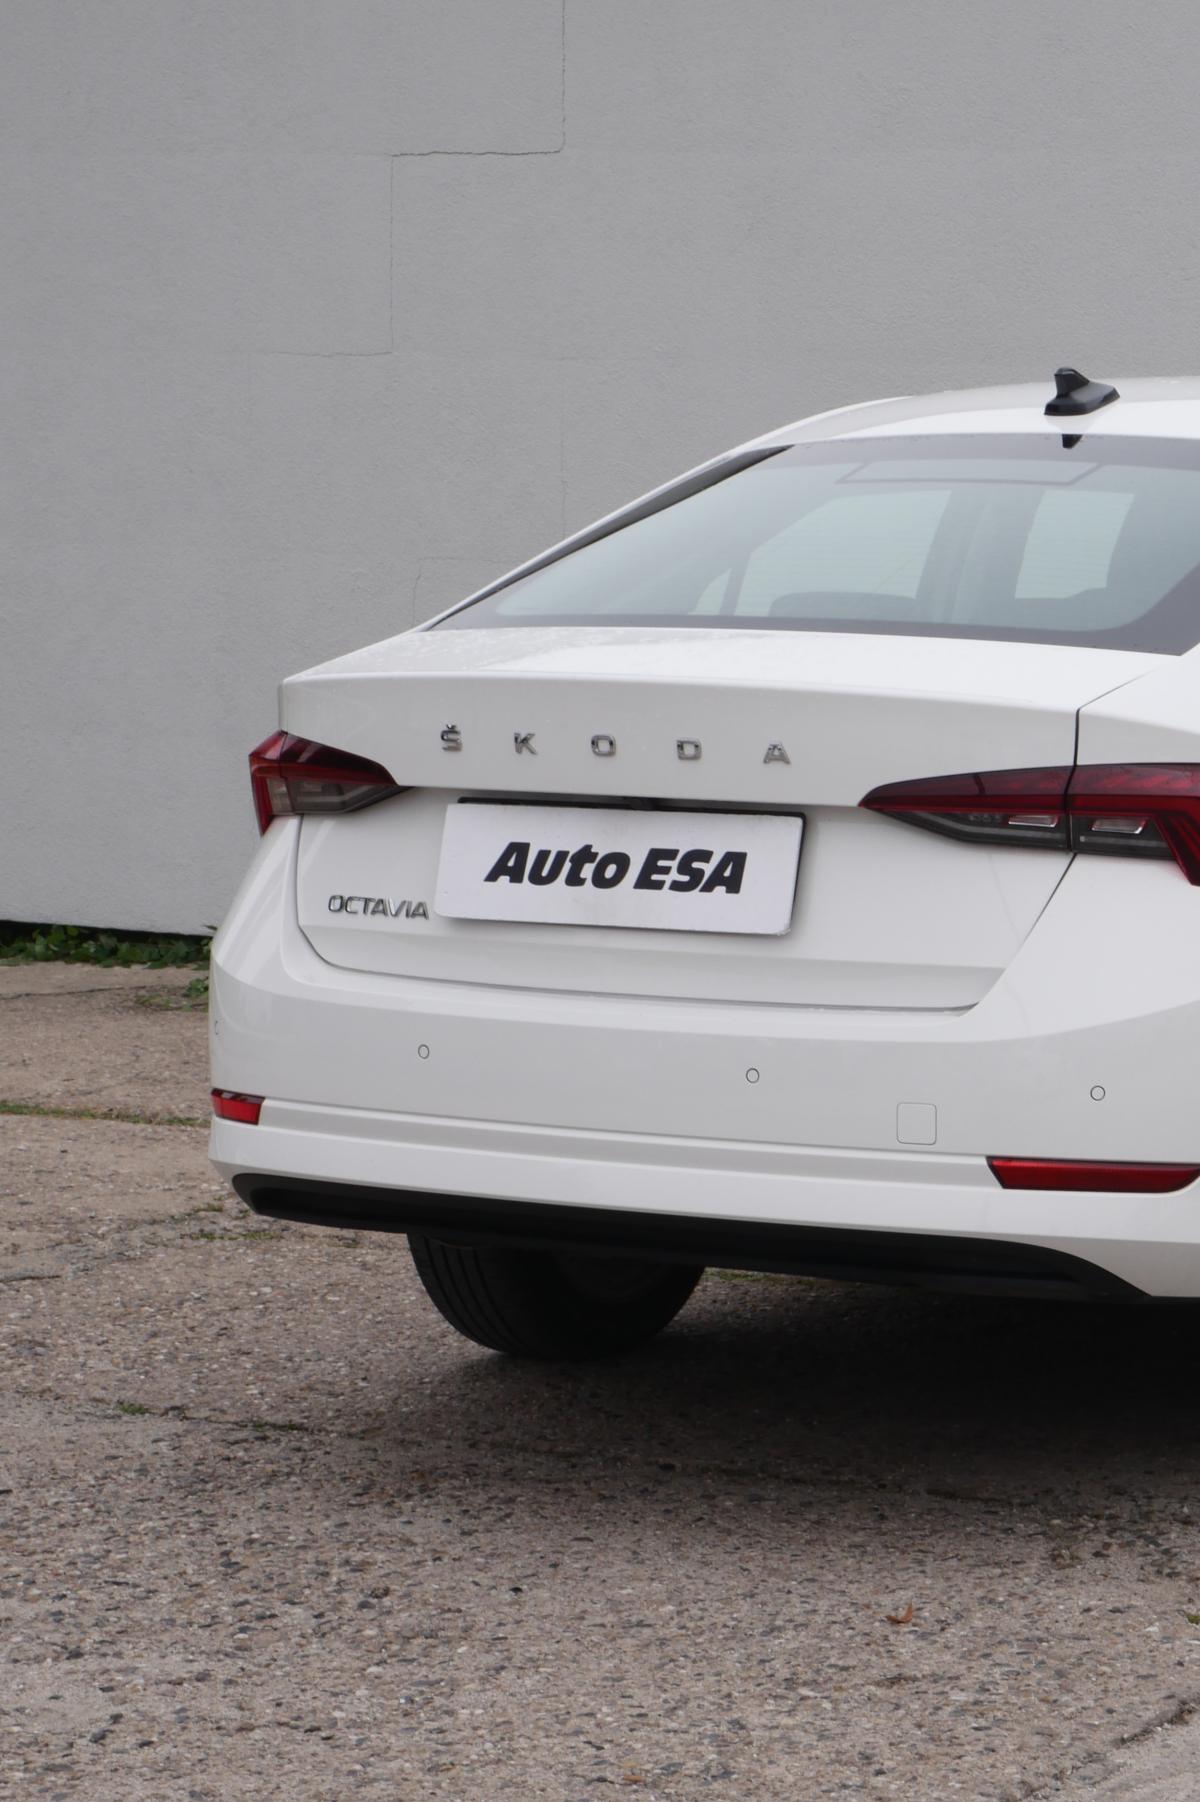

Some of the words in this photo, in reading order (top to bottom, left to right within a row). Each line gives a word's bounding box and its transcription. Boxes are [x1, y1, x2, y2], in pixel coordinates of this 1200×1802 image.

[441, 722, 792, 765] ŠKODA
[484, 841, 632, 890] Auto
[634, 847, 747, 895] ESA
[328, 894, 430, 921] OCTAVIA
